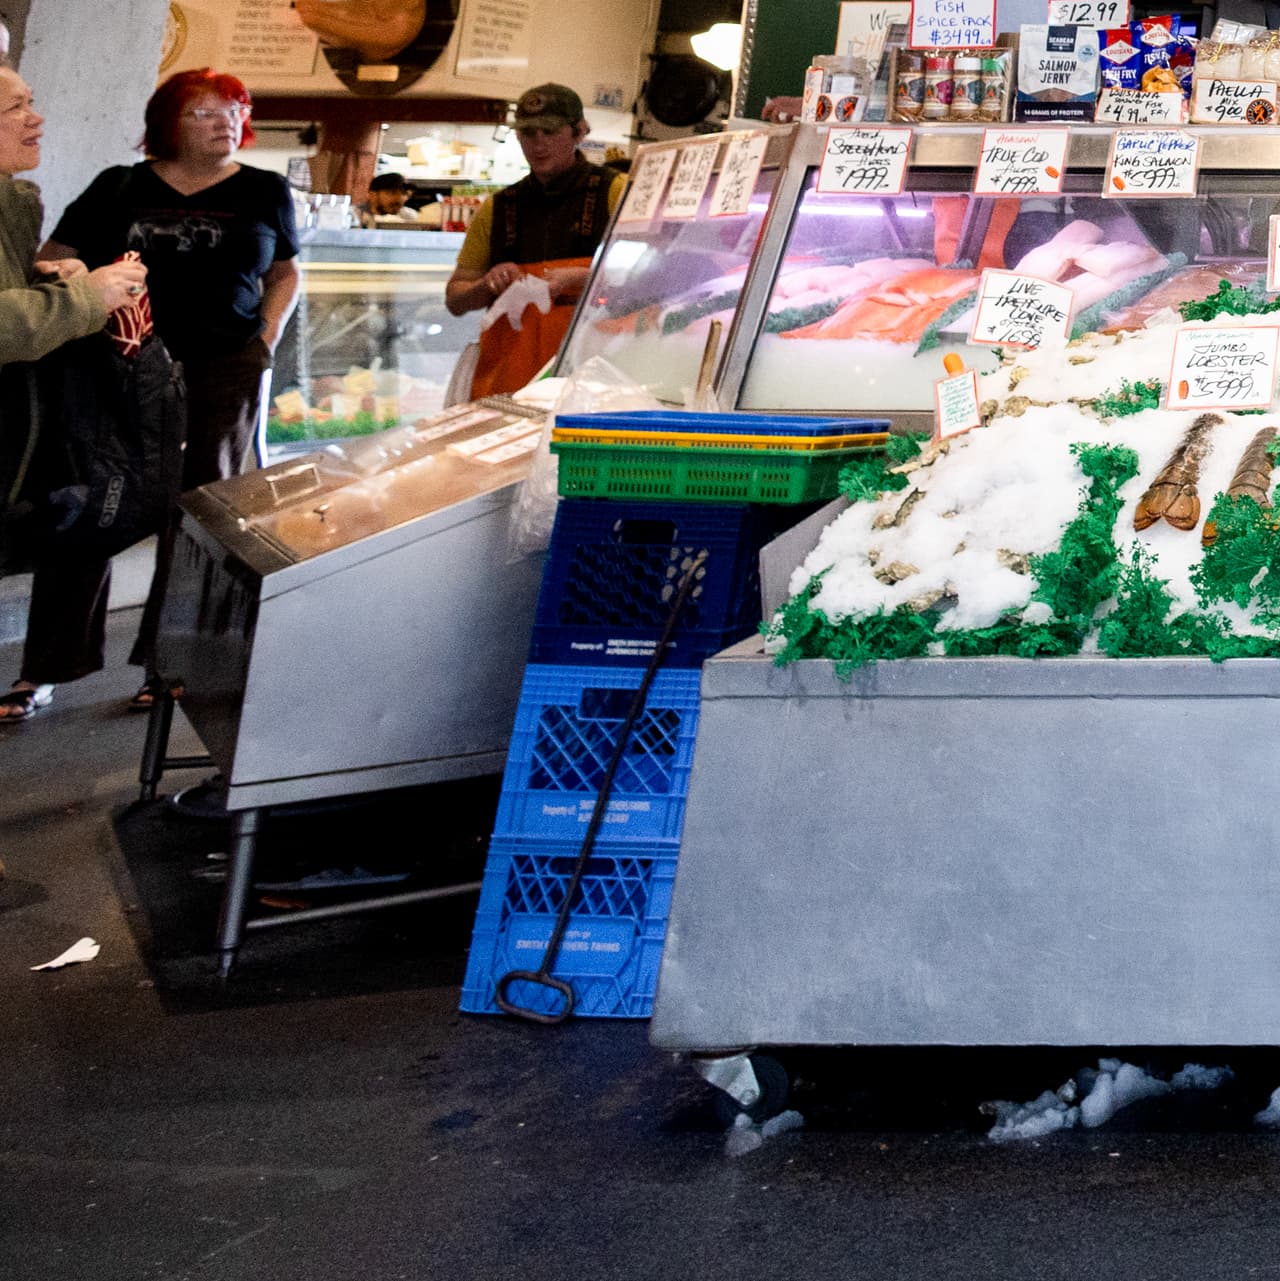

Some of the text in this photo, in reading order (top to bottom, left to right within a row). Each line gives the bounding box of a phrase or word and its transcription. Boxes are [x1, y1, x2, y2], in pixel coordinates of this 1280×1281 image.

[935, 0, 965, 12] FISH
[1057, 1, 1118, 23] $12.99
[917, 15, 992, 27] SPICE PACK
[1039, 59, 1077, 71] SALMON
[1041, 72, 1070, 84] JERKY
[1122, 67, 1137, 80] FRY
[1208, 80, 1271, 99] PAELLA
[1117, 138, 1155, 151] GARLIC
[982, 147, 1049, 163] TRUE COD
[1113, 155, 1192, 168] KING SALMON
[1008, 279, 1046, 295] LIVE
[1008, 308, 1044, 324] COVE
[1192, 342, 1247, 354] JUMBO
[1186, 353, 1268, 369] LOBSTER
